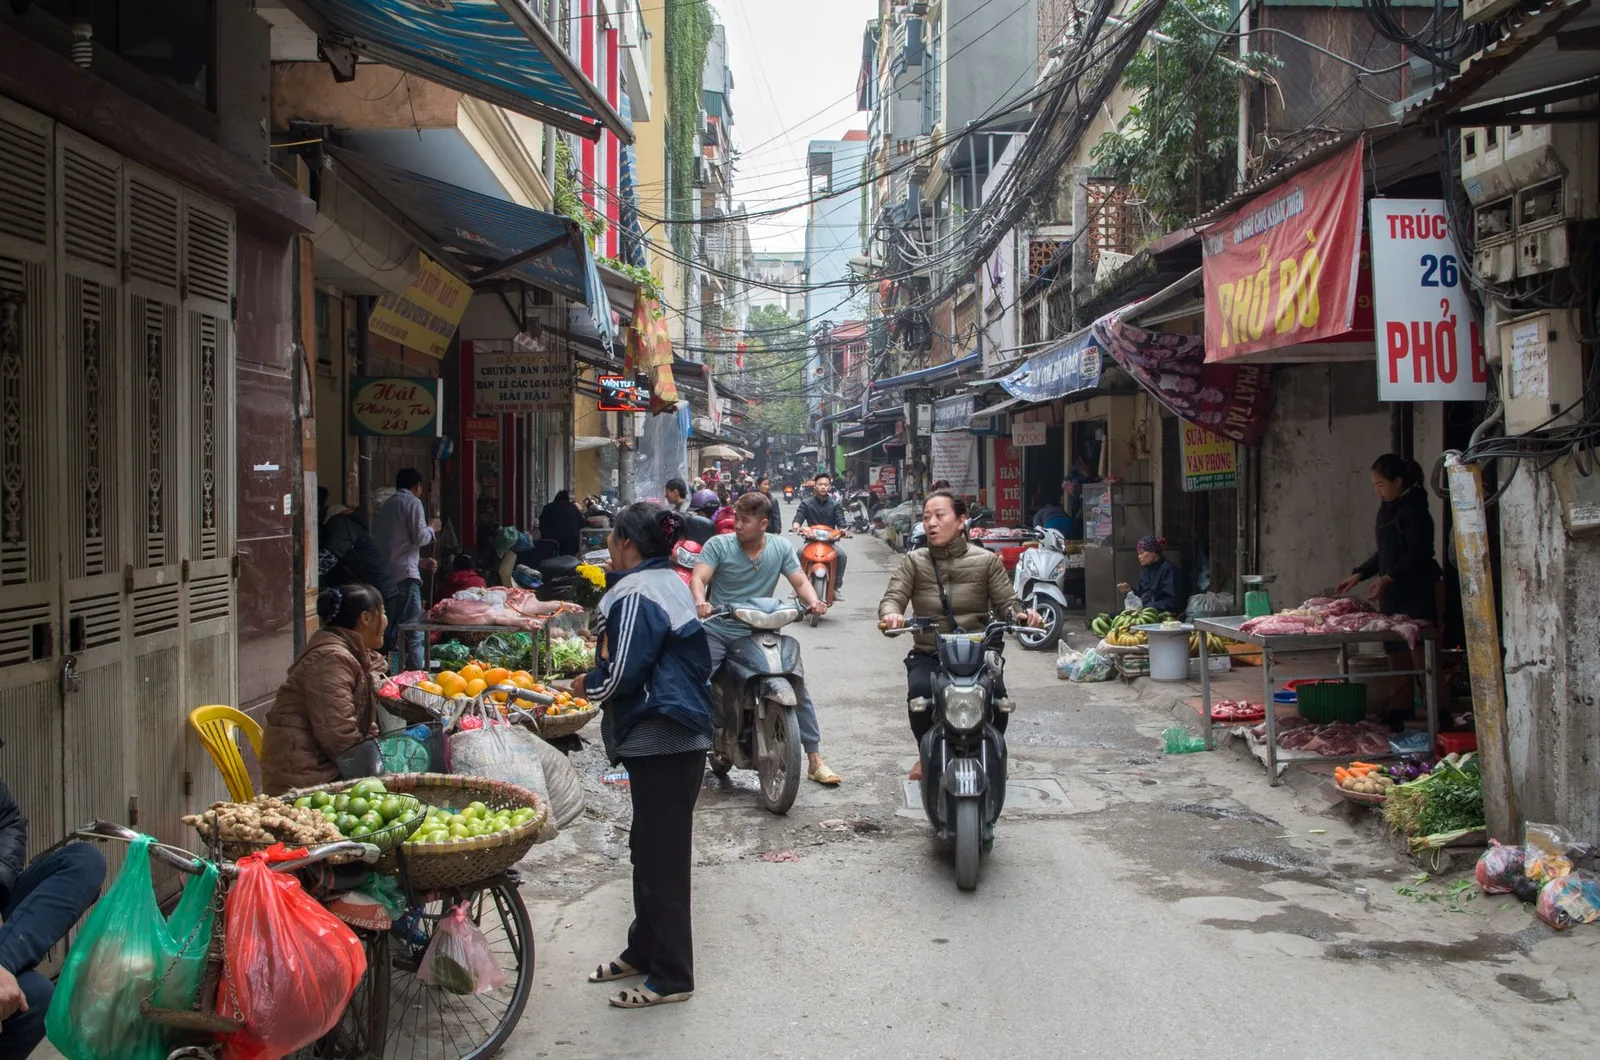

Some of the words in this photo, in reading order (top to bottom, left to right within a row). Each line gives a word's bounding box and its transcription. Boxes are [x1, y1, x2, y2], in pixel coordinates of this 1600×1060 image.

[1386, 208, 1447, 240] TRÚC
[1420, 254, 1459, 288] 26
[1218, 244, 1273, 348] PHỞ
[1275, 229, 1321, 335] BÒ
[1386, 298, 1458, 384] PHỞ
[480, 364, 517, 376] CHUYÊN
[1234, 364, 1261, 402] PHÁT
[381, 419, 409, 431] 243
